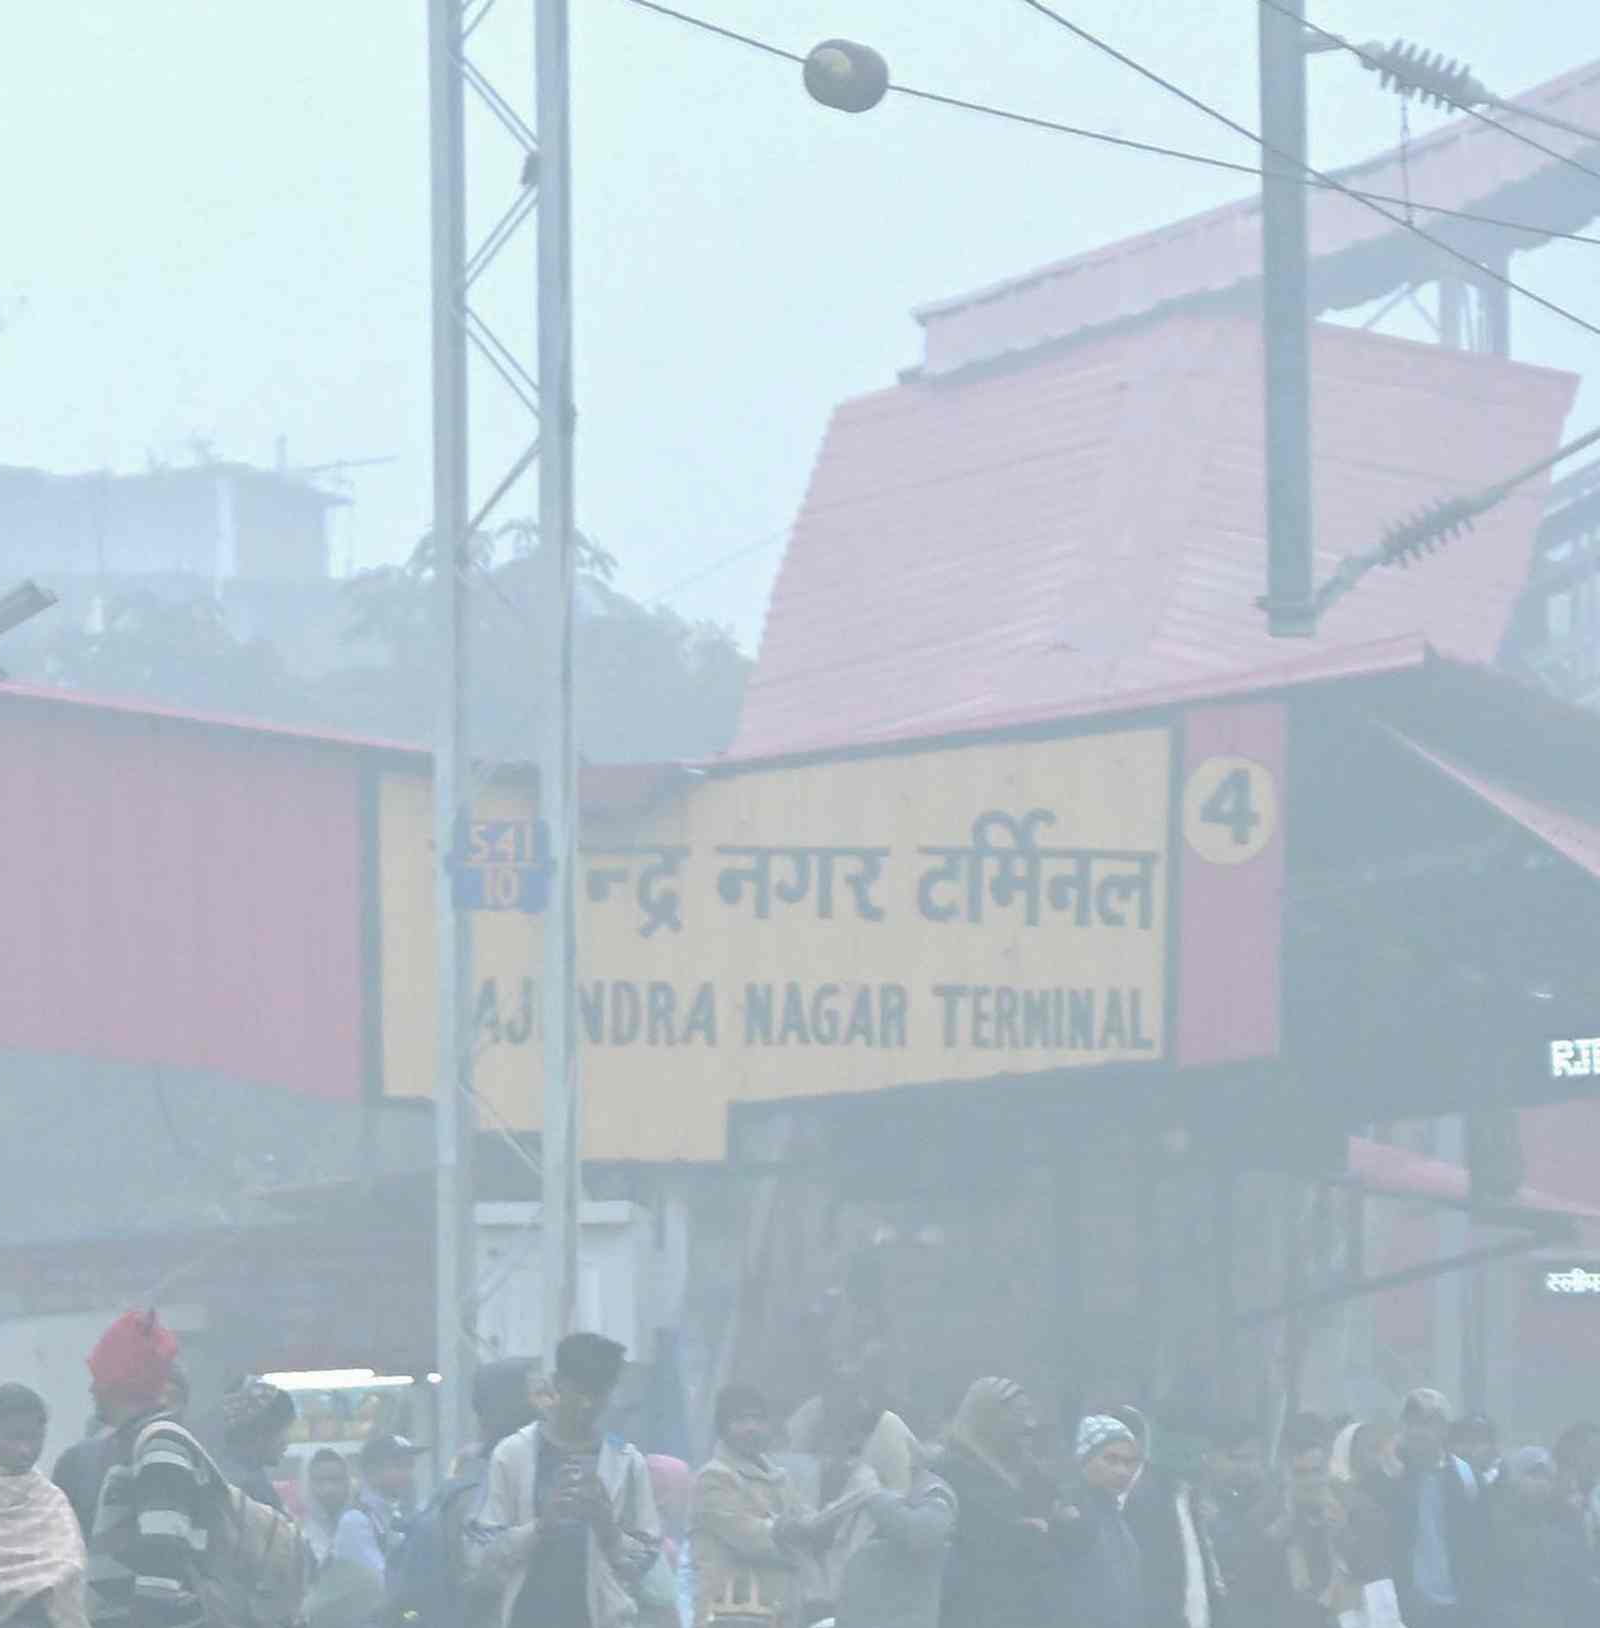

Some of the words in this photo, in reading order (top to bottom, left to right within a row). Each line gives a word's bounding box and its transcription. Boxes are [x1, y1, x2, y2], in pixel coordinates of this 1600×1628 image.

[1202, 766, 1259, 845] 4
[482, 868, 520, 905] 10
[714, 842, 889, 922] नगर
[915, 810, 1159, 929] टर्मिनल
[472, 978, 718, 1048] AJNDRA
[743, 982, 908, 1049] NAGAR
[934, 985, 1156, 1051] TERMINAL
